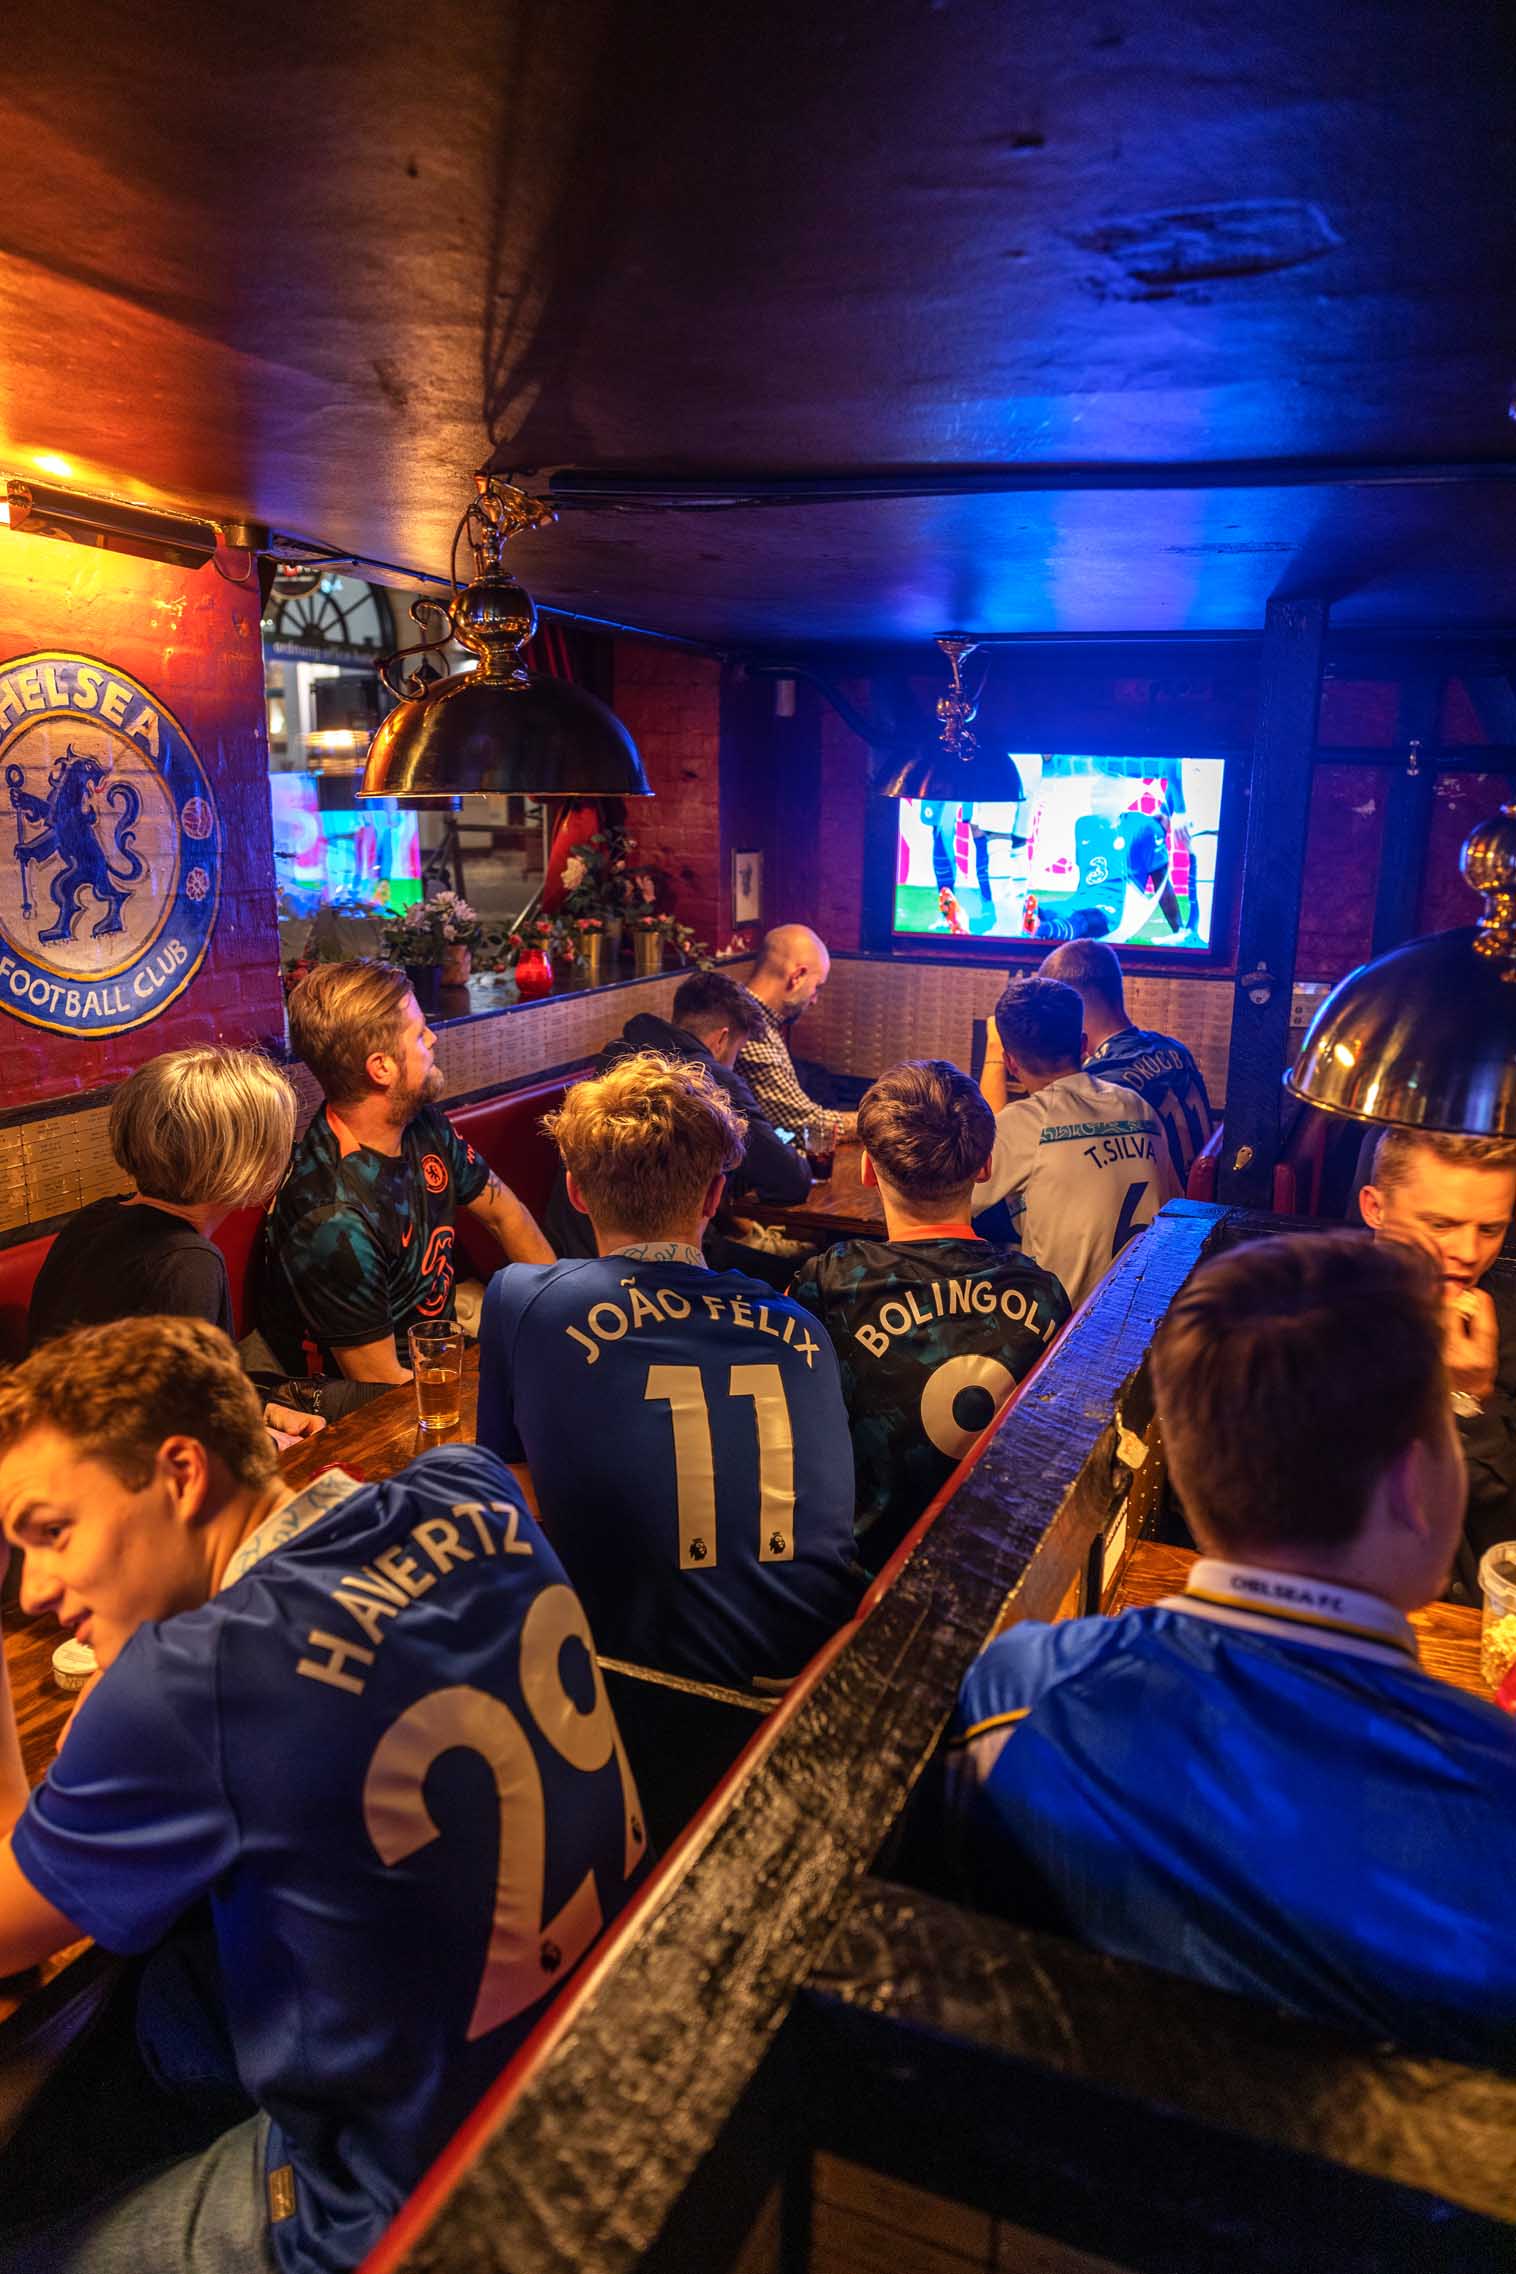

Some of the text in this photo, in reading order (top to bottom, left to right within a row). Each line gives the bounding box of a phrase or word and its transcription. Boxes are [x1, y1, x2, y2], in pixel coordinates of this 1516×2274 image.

[0, 667, 159, 758] HELSEA
[0, 938, 188, 1018] FOOTBALL CLUB
[1083, 1135, 1157, 1169] T.SILVA
[564, 1276, 820, 1368] JOÃO FÉLIX
[644, 1364, 796, 1570] 11
[296, 1502, 534, 1696] HAVERTZ
[363, 1583, 647, 2041] 29
